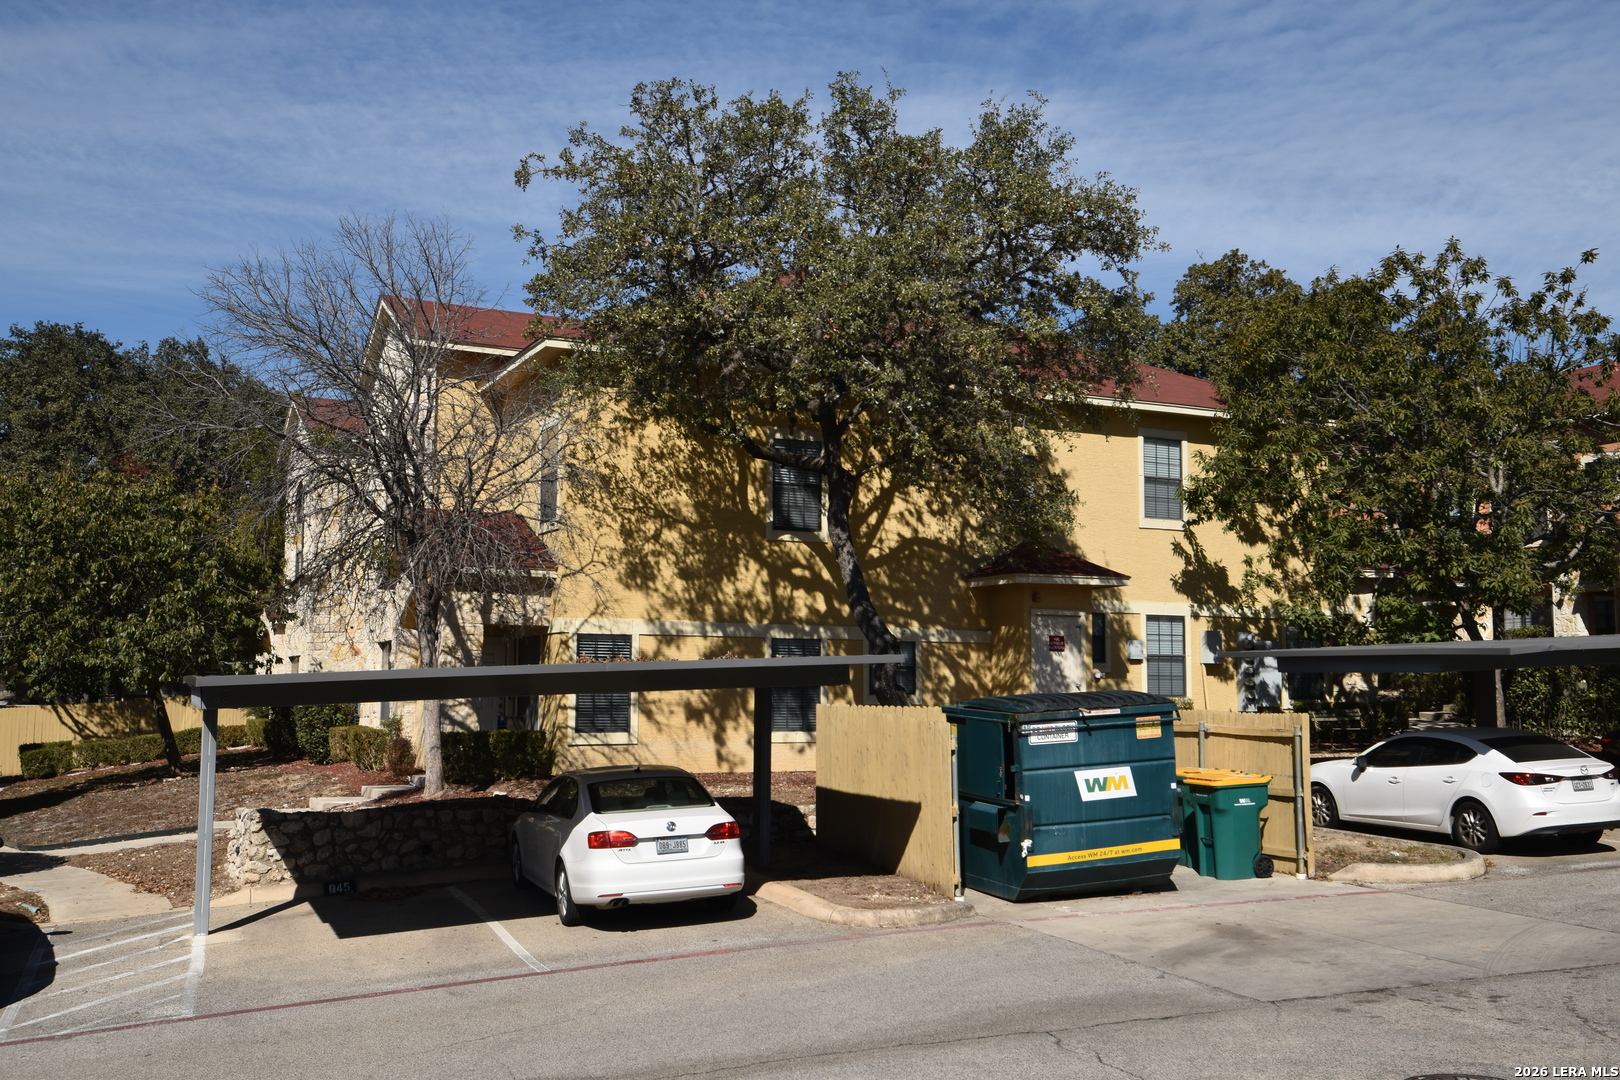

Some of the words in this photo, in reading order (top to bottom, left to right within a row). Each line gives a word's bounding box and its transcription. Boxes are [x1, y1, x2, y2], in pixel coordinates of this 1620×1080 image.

[1037, 732, 1069, 740] CONTAINER
[1084, 775, 1129, 793] WM
[1100, 849, 1113, 857] 24/7
[1121, 846, 1143, 854] wm.com
